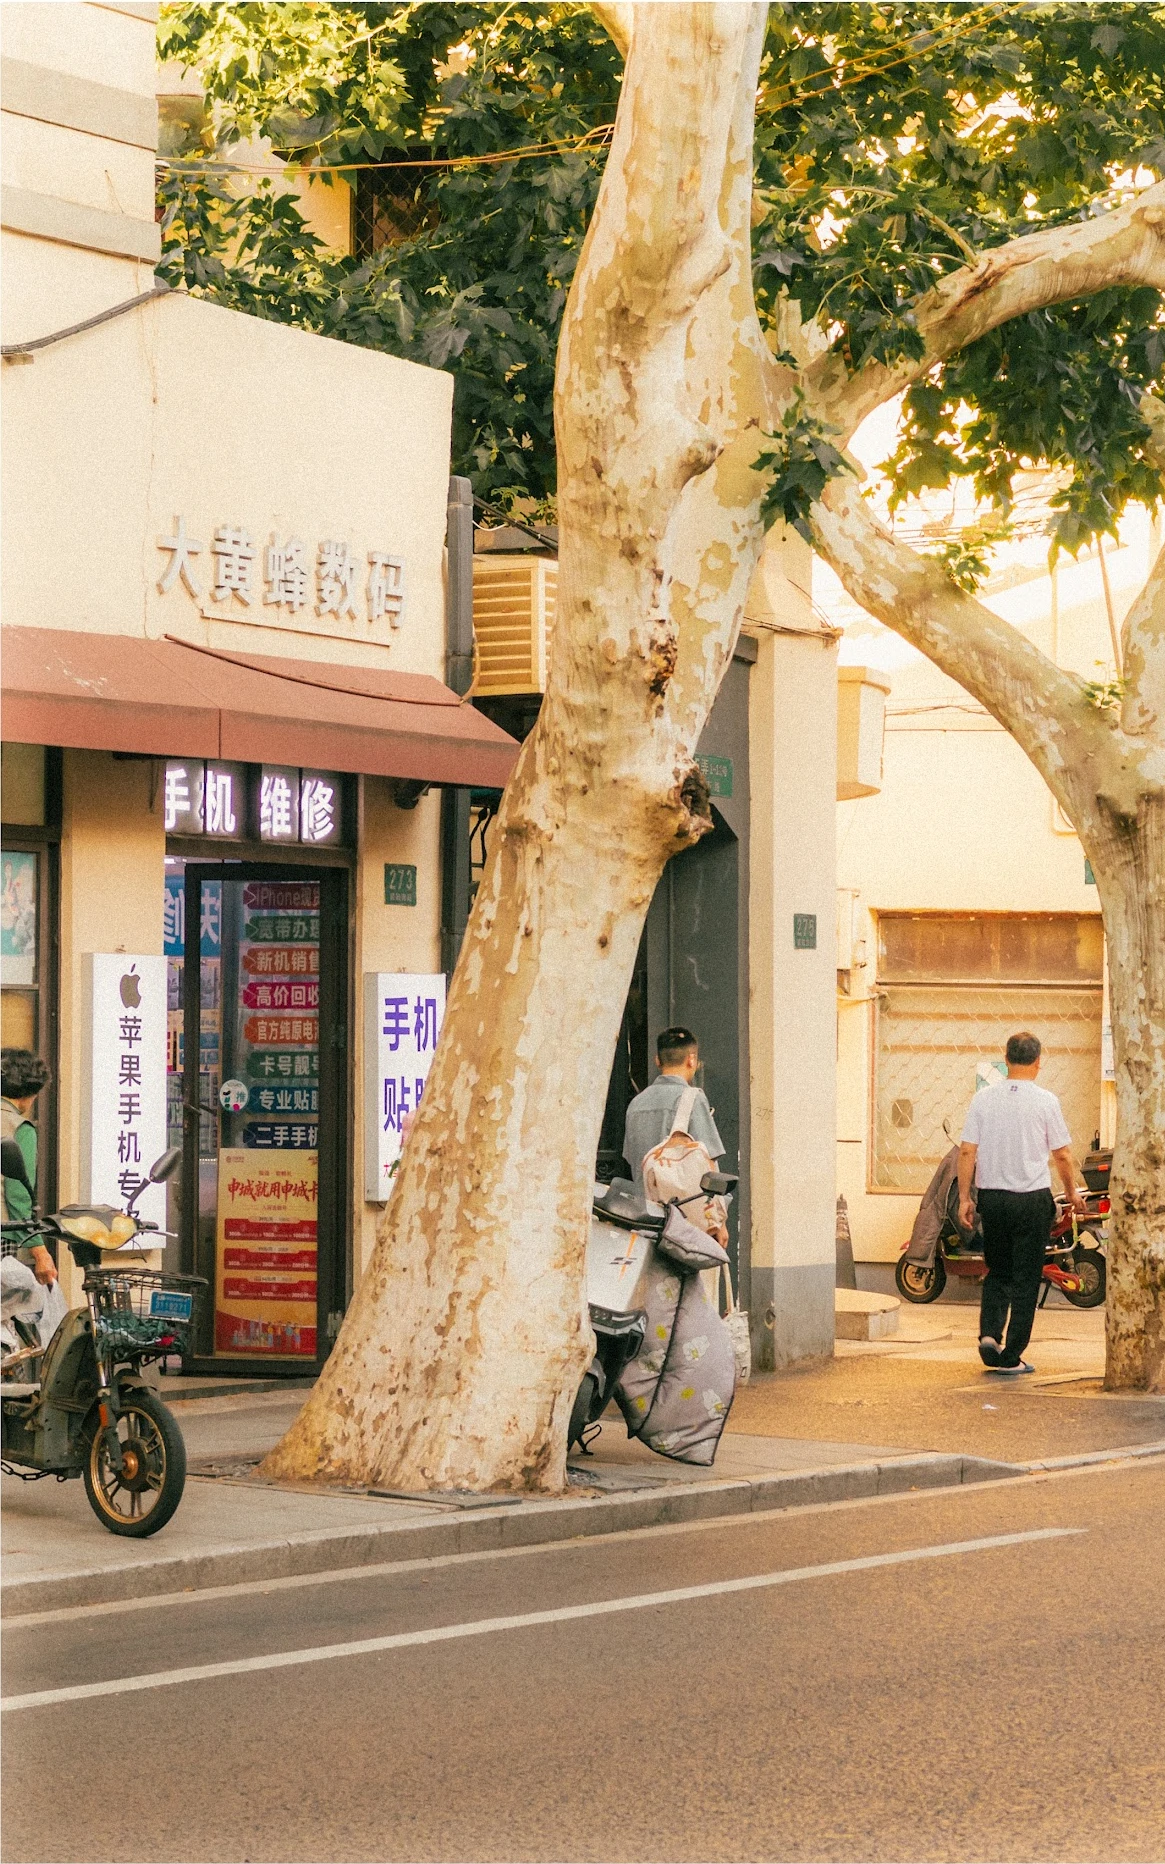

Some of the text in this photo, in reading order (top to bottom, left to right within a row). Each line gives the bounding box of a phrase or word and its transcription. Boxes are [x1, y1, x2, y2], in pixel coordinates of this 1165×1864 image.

[156, 514, 406, 629] 大黄蜂数码
[389, 869, 413, 891] 273
[256, 950, 319, 972] 新机销售
[256, 985, 319, 1007] 高价回收
[382, 996, 440, 1052] 手机
